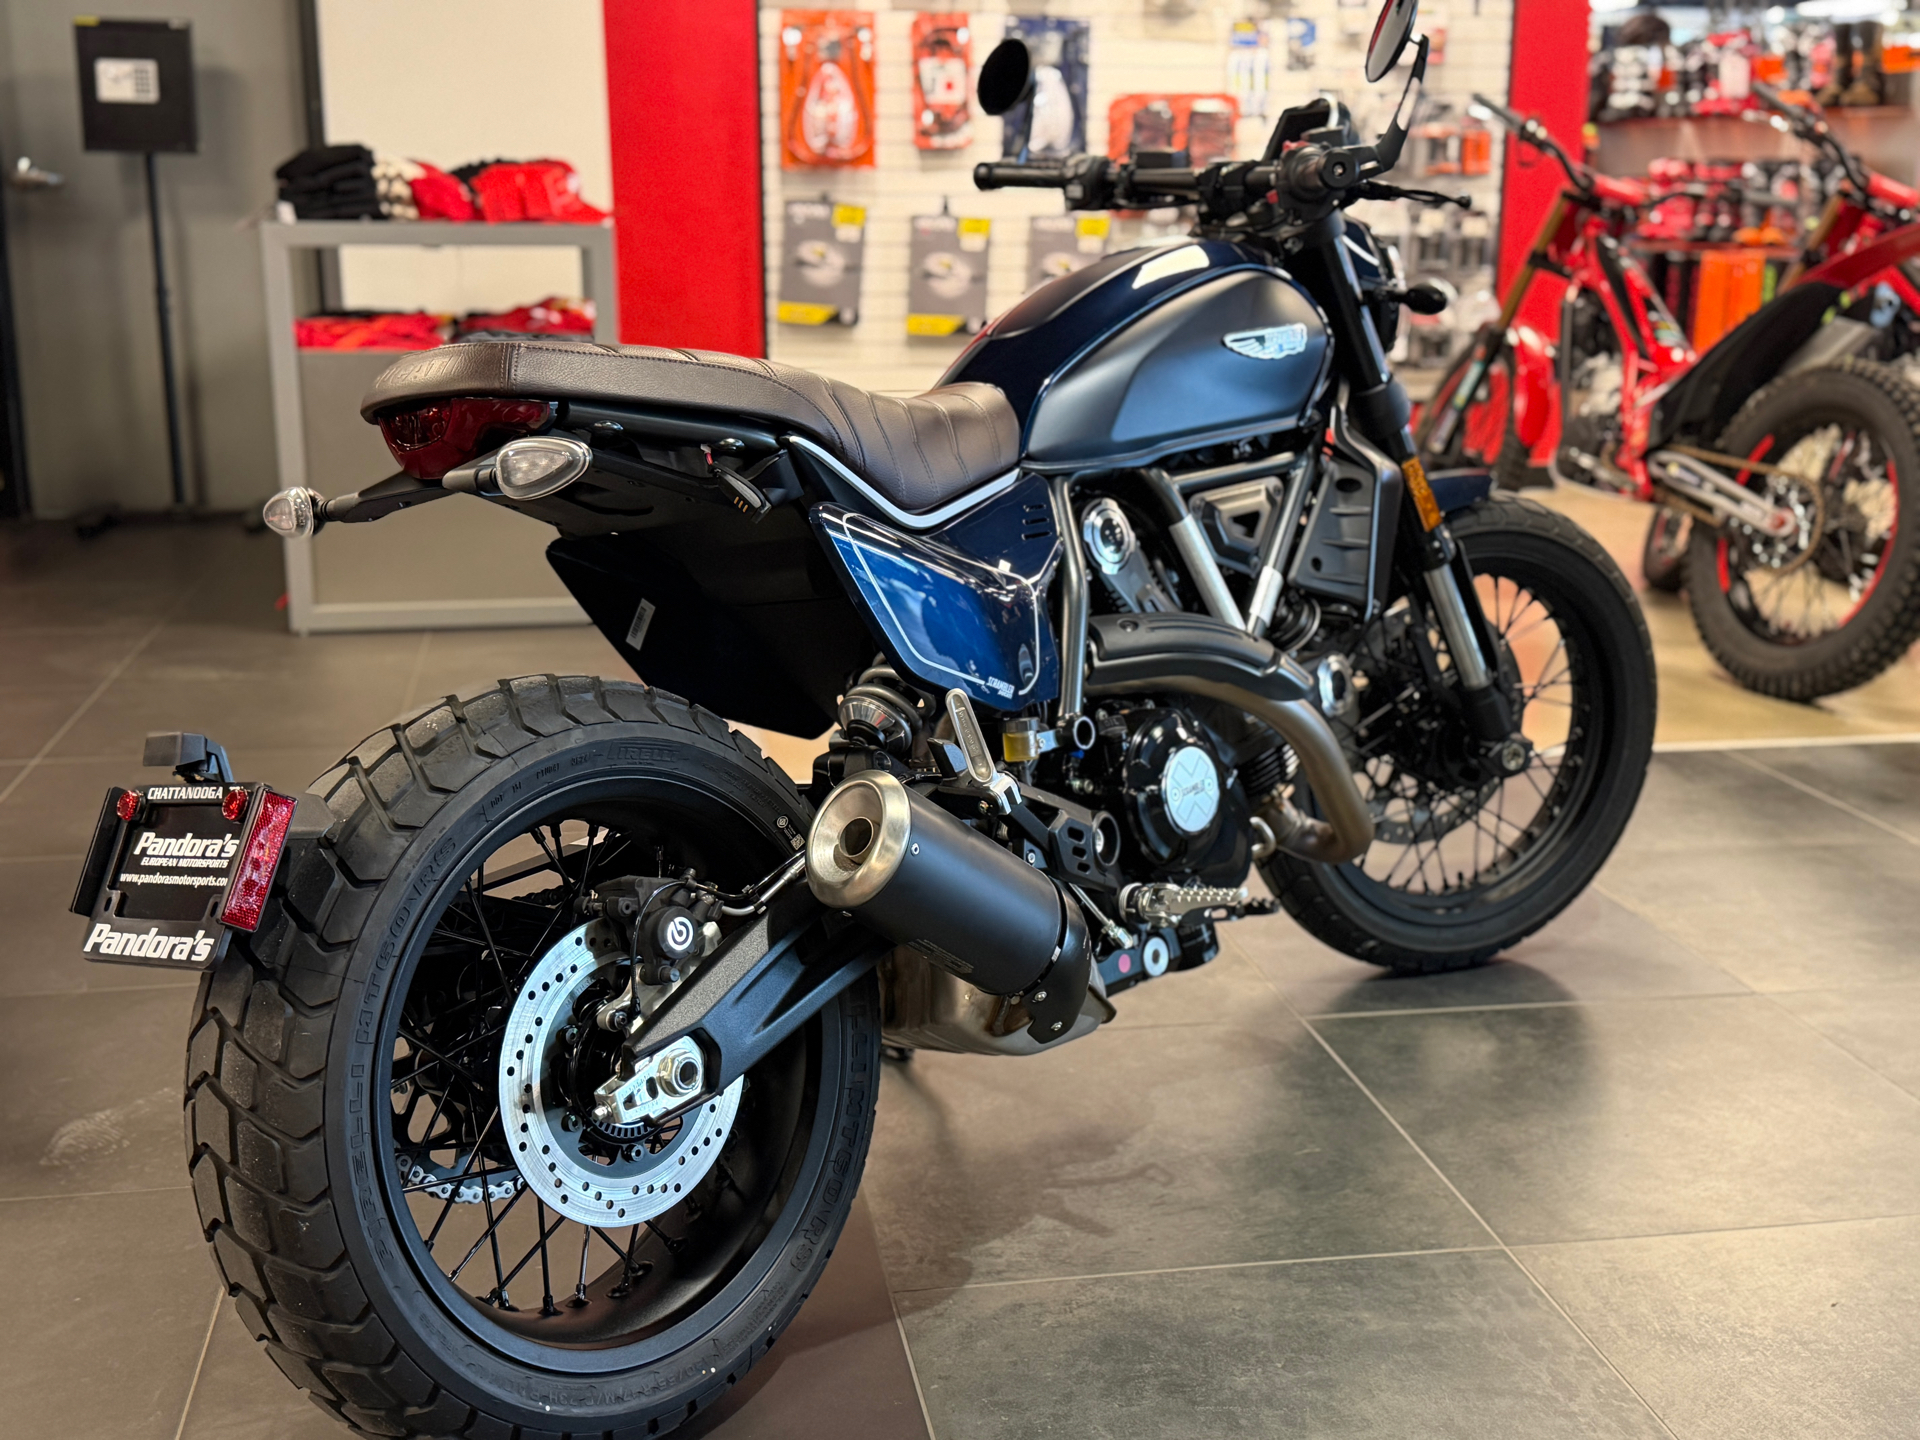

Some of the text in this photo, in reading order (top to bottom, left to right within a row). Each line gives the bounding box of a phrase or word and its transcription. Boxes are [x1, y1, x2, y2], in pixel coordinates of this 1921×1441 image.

[147, 786, 224, 800] CHATTANOOGA
[133, 831, 240, 858] Pandora's
[140, 857, 230, 869] EUROPEAN MOTORSPORTS
[83, 923, 216, 962] Pandora's
